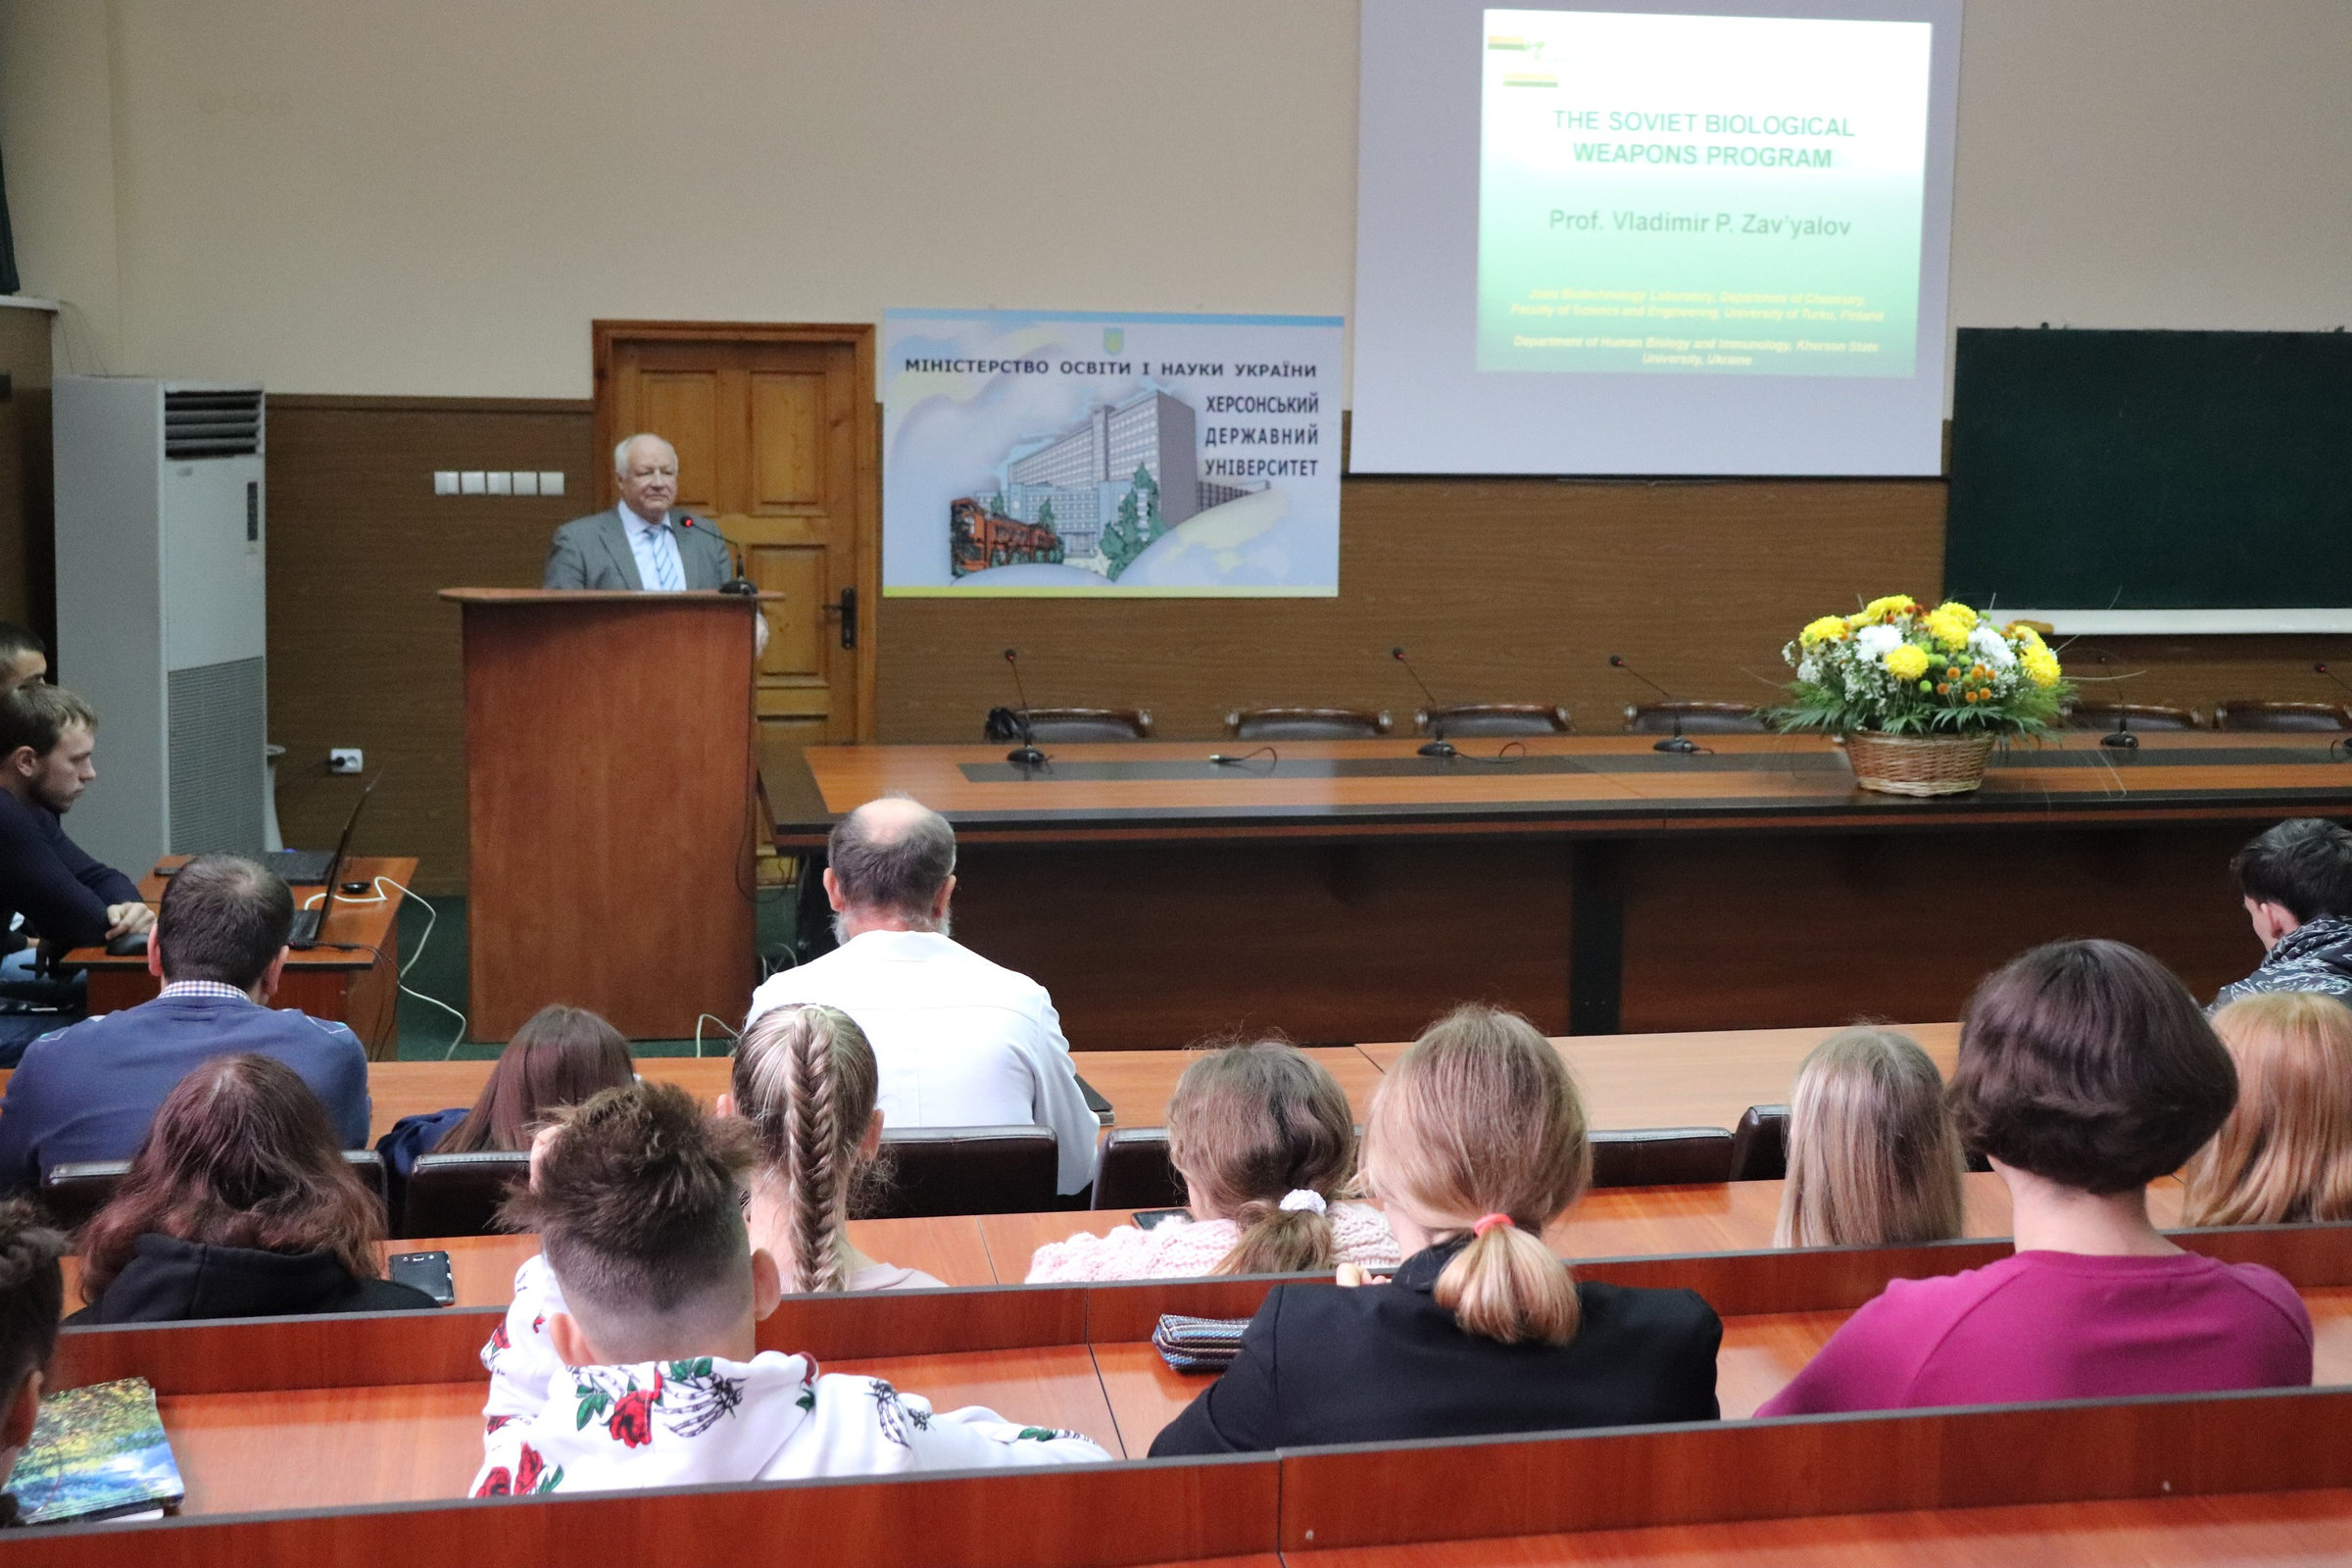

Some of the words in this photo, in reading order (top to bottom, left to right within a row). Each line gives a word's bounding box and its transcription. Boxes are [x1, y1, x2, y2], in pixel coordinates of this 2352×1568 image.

[1553, 110, 1599, 130] THE
[1608, 111, 1697, 133] SOVIET
[1705, 114, 1855, 137] BIOLOGICAL
[1573, 142, 1697, 165] WEAPONS
[1707, 146, 1832, 169] PROGRAM
[1549, 210, 1604, 231] Prof.
[1613, 211, 1709, 233] Vladimir
[1716, 214, 1733, 234] P.
[1513, 335, 1583, 348] Department
[1599, 336, 1642, 348] Human
[1645, 336, 1690, 350] Biology
[1693, 338, 1716, 349] and
[1796, 339, 1846, 351] Kherson
[906, 359, 1049, 374] МІНІСТЕРСТВО
[1060, 360, 1131, 375] ОСВІТИ
[1161, 363, 1224, 377] НАУКИ
[1235, 360, 1318, 377] УКРАЇНИ
[1707, 353, 1752, 366] Ukraine
[1205, 392, 1319, 414] ХЕРСОНСЬКИЙ
[1205, 424, 1319, 447] ДЕРЖАВНИЙ
[1205, 459, 1318, 477] УНІВЕРСИТЕТ
